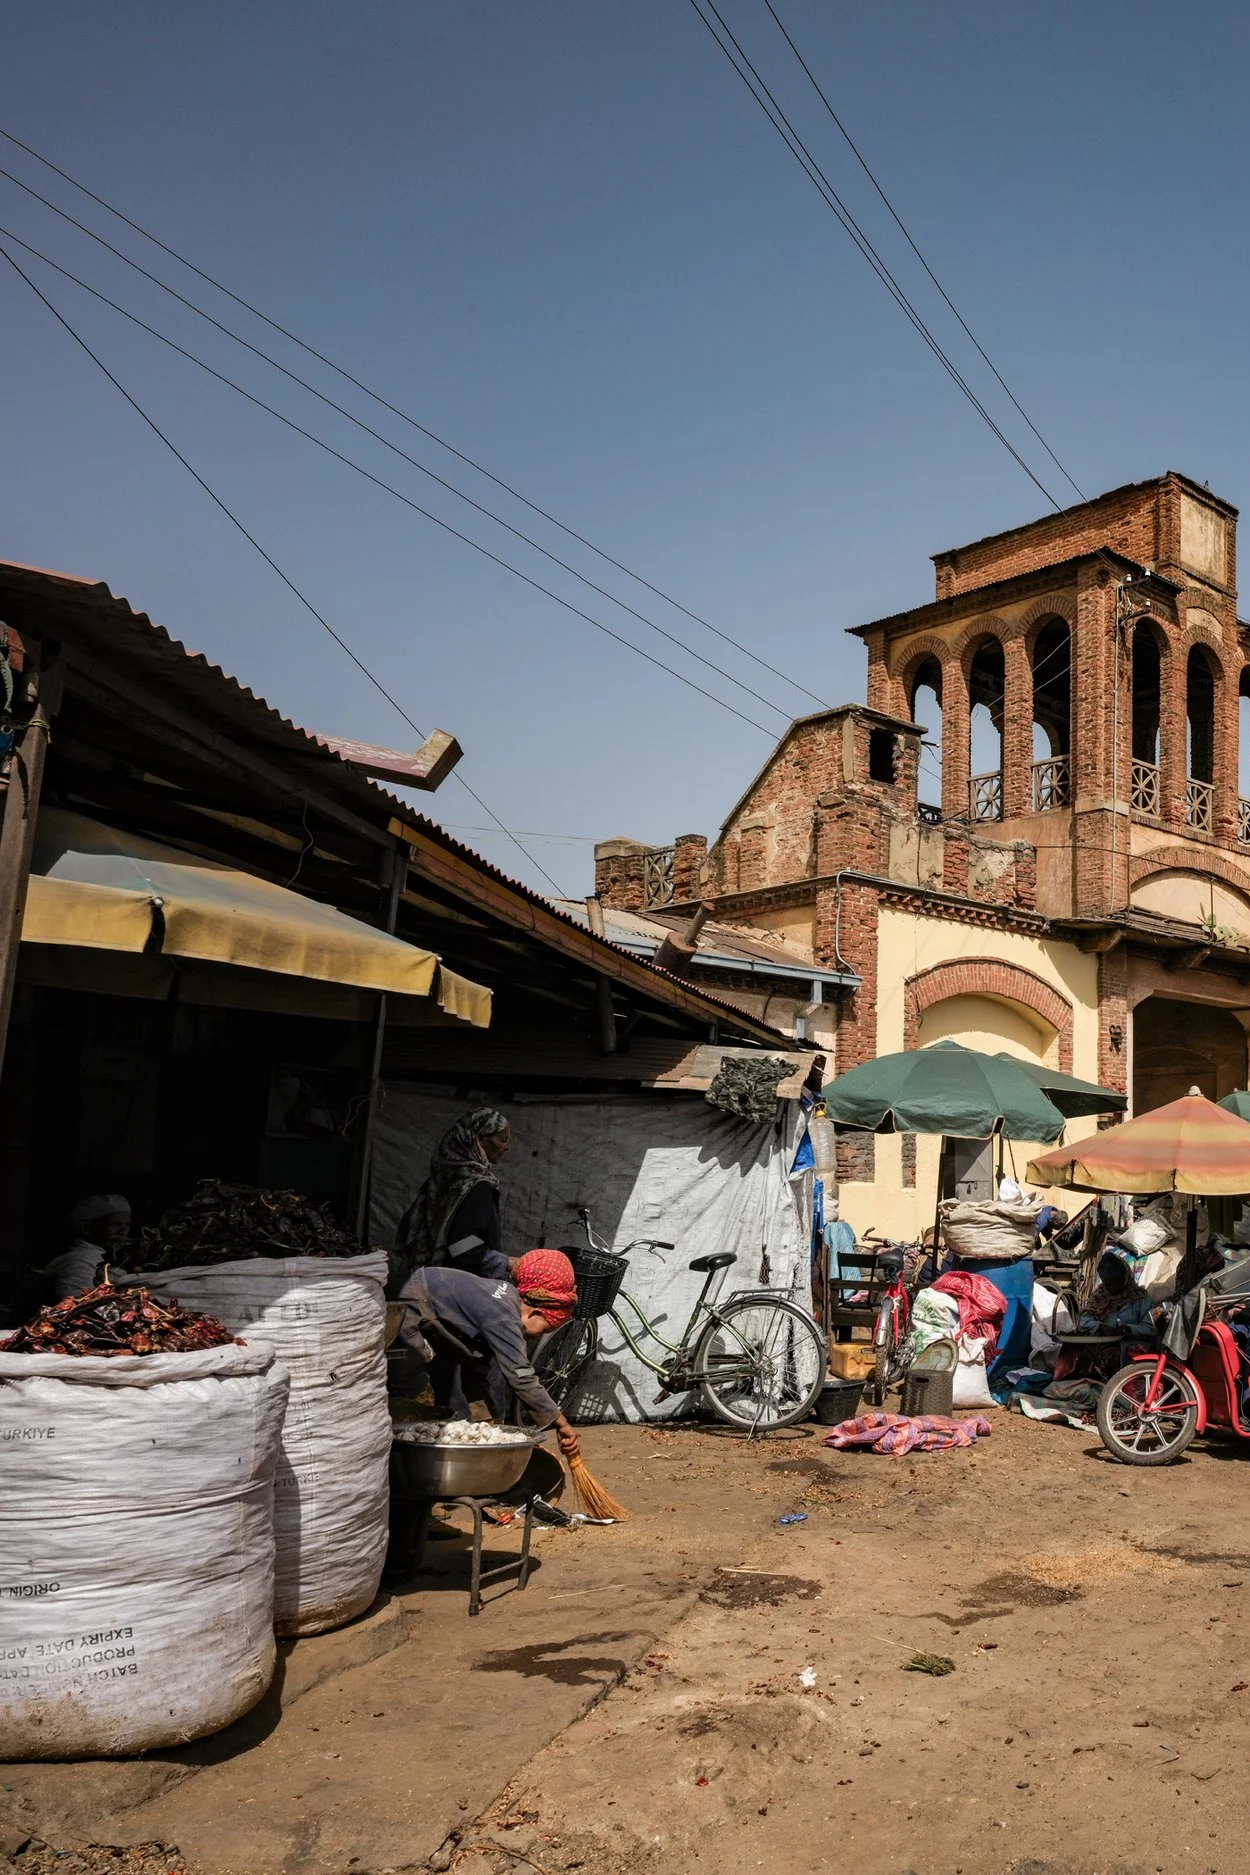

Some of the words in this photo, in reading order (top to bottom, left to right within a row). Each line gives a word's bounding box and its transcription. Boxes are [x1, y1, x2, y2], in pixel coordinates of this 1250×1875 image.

[2, 1427, 56, 1441] URKIYE
[80, 1627, 133, 1648] EXPIRY
[35, 1639, 75, 1656] DATE
[0, 1665, 30, 1680] DAT
[88, 1662, 138, 1685] BATCH
